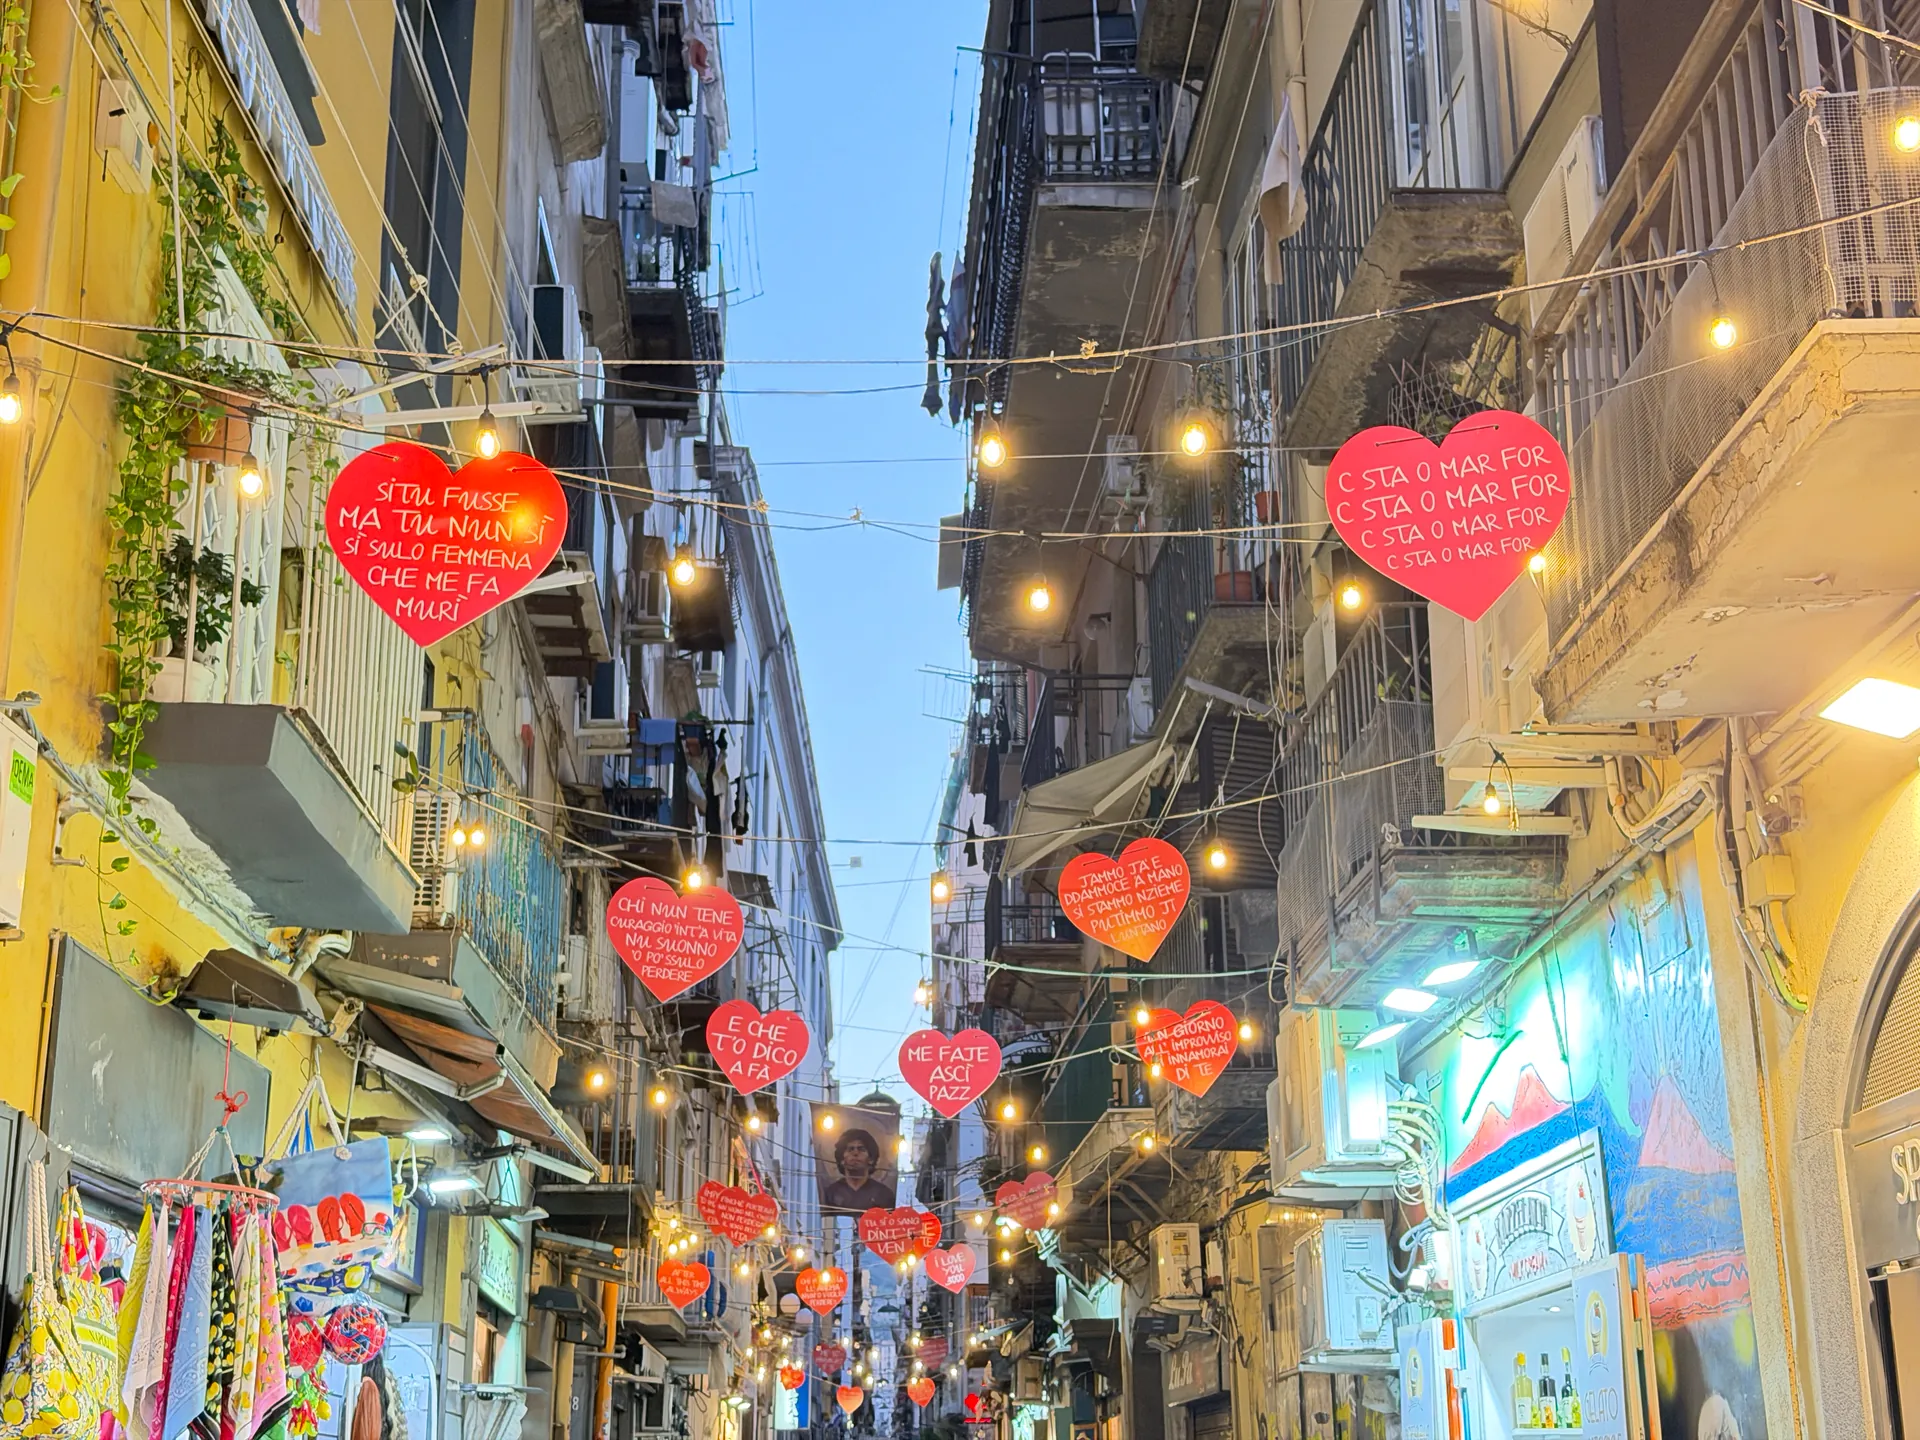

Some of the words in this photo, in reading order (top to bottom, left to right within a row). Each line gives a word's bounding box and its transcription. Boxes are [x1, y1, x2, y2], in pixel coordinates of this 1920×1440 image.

[1338, 472, 1355, 492] C
[1362, 465, 1409, 490] STA
[1416, 462, 1431, 482] O
[1439, 453, 1496, 479] MAR
[1500, 446, 1552, 470] FOR
[443, 486, 519, 512] FUSSE
[1336, 501, 1354, 524] C
[1362, 494, 1412, 522] STA
[1420, 490, 1435, 512] O
[1445, 481, 1506, 509] MAR
[1511, 473, 1566, 500] FOR
[339, 506, 381, 530] MA
[392, 509, 438, 536] TU
[449, 515, 513, 542] NUN
[1361, 530, 1376, 548] C
[1382, 523, 1425, 547] STA
[1430, 520, 1444, 539] O
[1451, 513, 1503, 536] MAR
[1506, 506, 1552, 529] FOR
[367, 539, 424, 561] SULO
[431, 545, 532, 570] FEMMENA
[1387, 554, 1400, 570] C
[1403, 550, 1437, 568] STA
[1442, 547, 1452, 563] O
[1458, 541, 1498, 561] MAR
[1500, 536, 1536, 554] FOR
[367, 565, 419, 588] CHE
[425, 571, 460, 592] ME
[467, 573, 500, 596] FA
[395, 594, 468, 622] MURÌ
[1063, 877, 1131, 906] DDAMMOCE
[1147, 863, 1183, 884] MANO
[1078, 866, 1125, 888] JAMMO
[1152, 855, 1163, 870] E
[618, 896, 646, 913] CHI
[651, 902, 688, 919] NUN
[692, 907, 734, 925] TENE
[1087, 893, 1133, 916] STAMMO
[1135, 879, 1184, 903] NZIEME
[610, 915, 672, 933] CURAGGIO
[713, 928, 738, 943] VITA
[1090, 905, 1155, 934] PUTIMMO
[1110, 919, 1167, 944] LUNTANO
[625, 933, 652, 949] NU
[655, 936, 718, 957] SUONNO
[641, 965, 693, 983] PERDERE
[728, 1015, 744, 1033] E
[747, 1020, 788, 1042] CHE
[1173, 1016, 1225, 1038] GIORNO
[711, 1032, 747, 1055] T'O
[752, 1041, 797, 1066] DICO
[908, 1045, 933, 1062] ME
[939, 1045, 990, 1063] FAJE
[1167, 1042, 1229, 1066] INNAMORAI
[729, 1060, 743, 1075] A
[747, 1063, 770, 1080] FÀ
[1175, 1063, 1190, 1081] DI
[1192, 1062, 1213, 1077] TE
[929, 1085, 971, 1101] PAZZ
[865, 1219, 878, 1228] TU
[897, 1217, 920, 1226] SANG
[877, 1241, 905, 1255] VEN
[940, 1252, 965, 1267] LOVE
[941, 1263, 965, 1276] YOU
